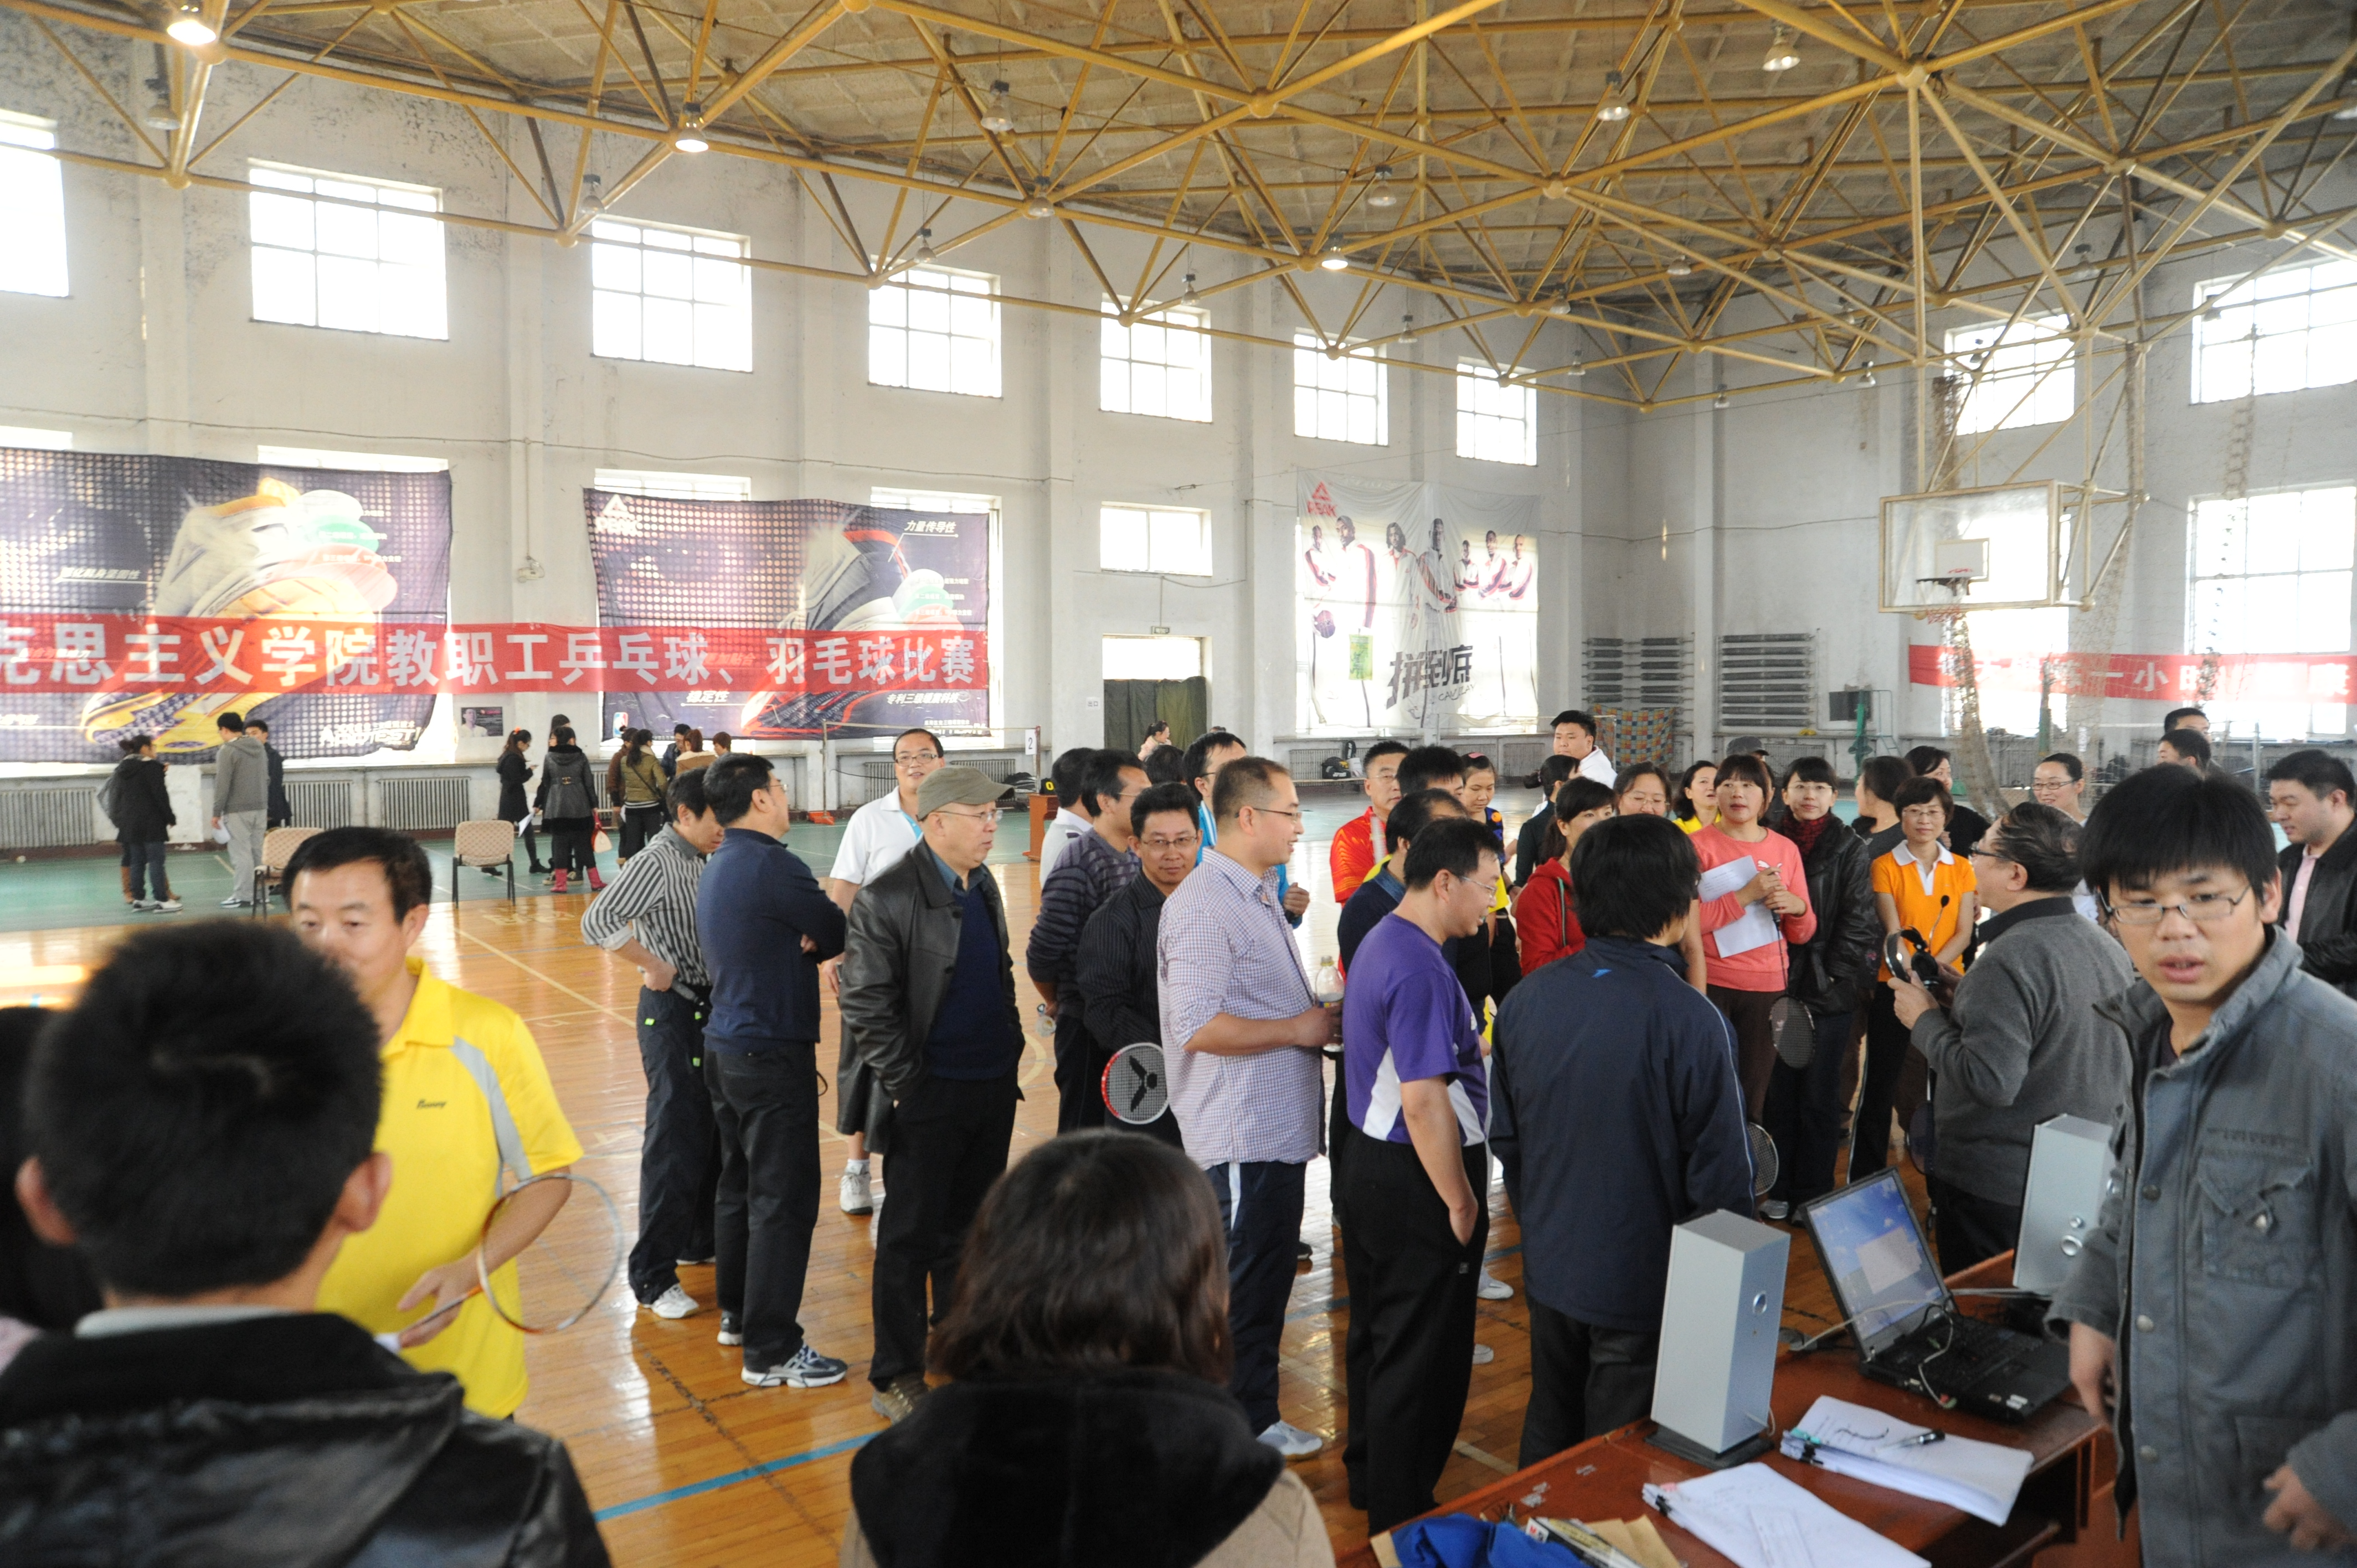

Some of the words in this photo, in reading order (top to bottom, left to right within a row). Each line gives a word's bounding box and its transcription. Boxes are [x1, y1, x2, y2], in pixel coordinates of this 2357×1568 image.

[1307, 501, 1337, 517] PEAK
[904, 520, 957, 533] 力量传导性
[1386, 644, 1473, 710] 拼到底
[686, 690, 730, 703] 稳定性
[1028, 737, 1033, 749] 2
